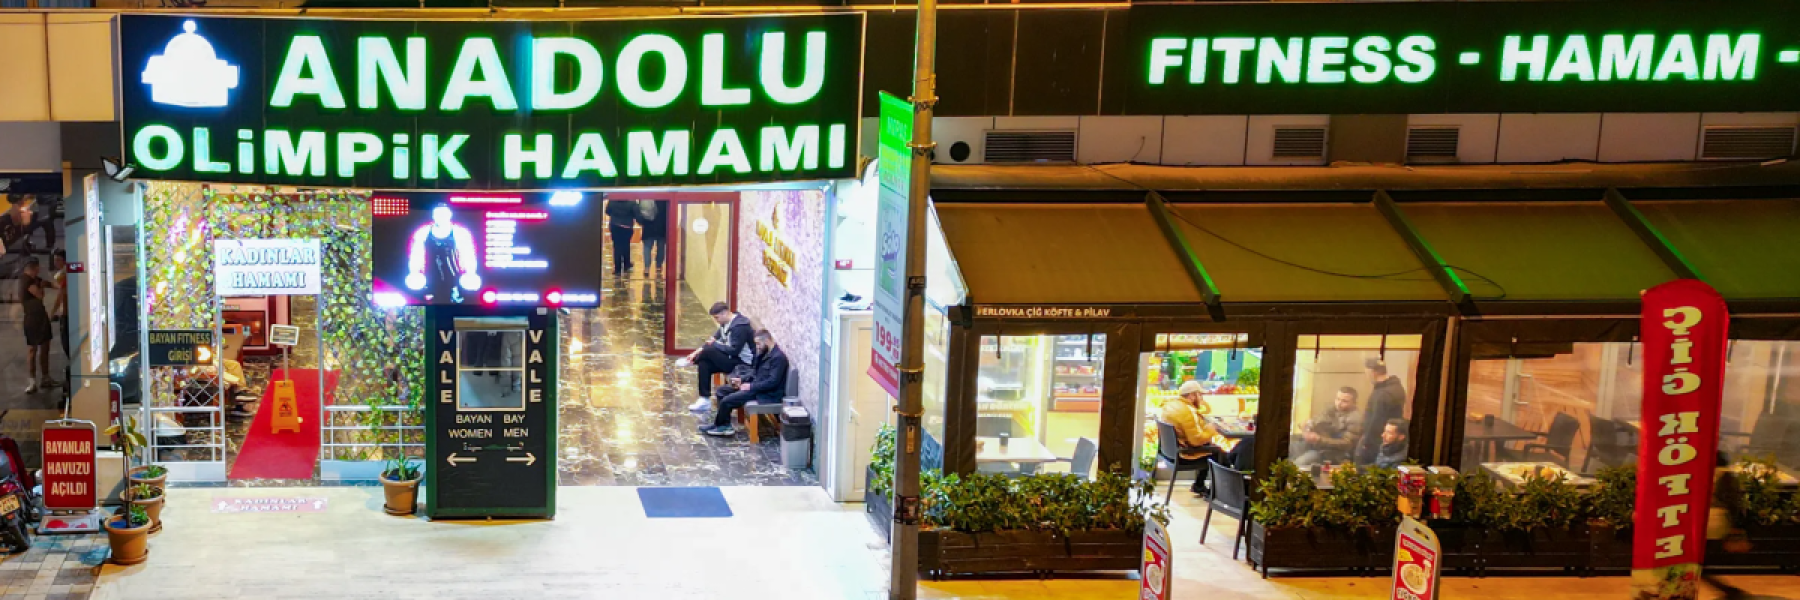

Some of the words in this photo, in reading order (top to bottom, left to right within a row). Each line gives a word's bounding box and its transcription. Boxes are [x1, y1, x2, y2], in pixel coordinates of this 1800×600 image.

[1148, 36, 1436, 84] FITNESS
[1500, 34, 1761, 82] HAMAM
[270, 31, 827, 110] ANADOLU
[504, 124, 846, 179] HAMAMI
[221, 248, 316, 265] KADINLAR
[232, 271, 307, 288] HAMAMI
[1044, 306, 1073, 316] KÖFTE
[150, 333, 176, 344] BAYAN
[439, 329, 454, 403] VALE
[529, 329, 544, 403] VALE
[456, 414, 492, 424] BAYAN
[503, 414, 526, 424] BAY
[448, 429, 493, 438] WOMEN
[503, 428, 529, 437] MEN
[45, 440, 91, 454] BAYANLAR
[47, 461, 91, 475] HAVUZU
[51, 481, 88, 497] AÇILDI
